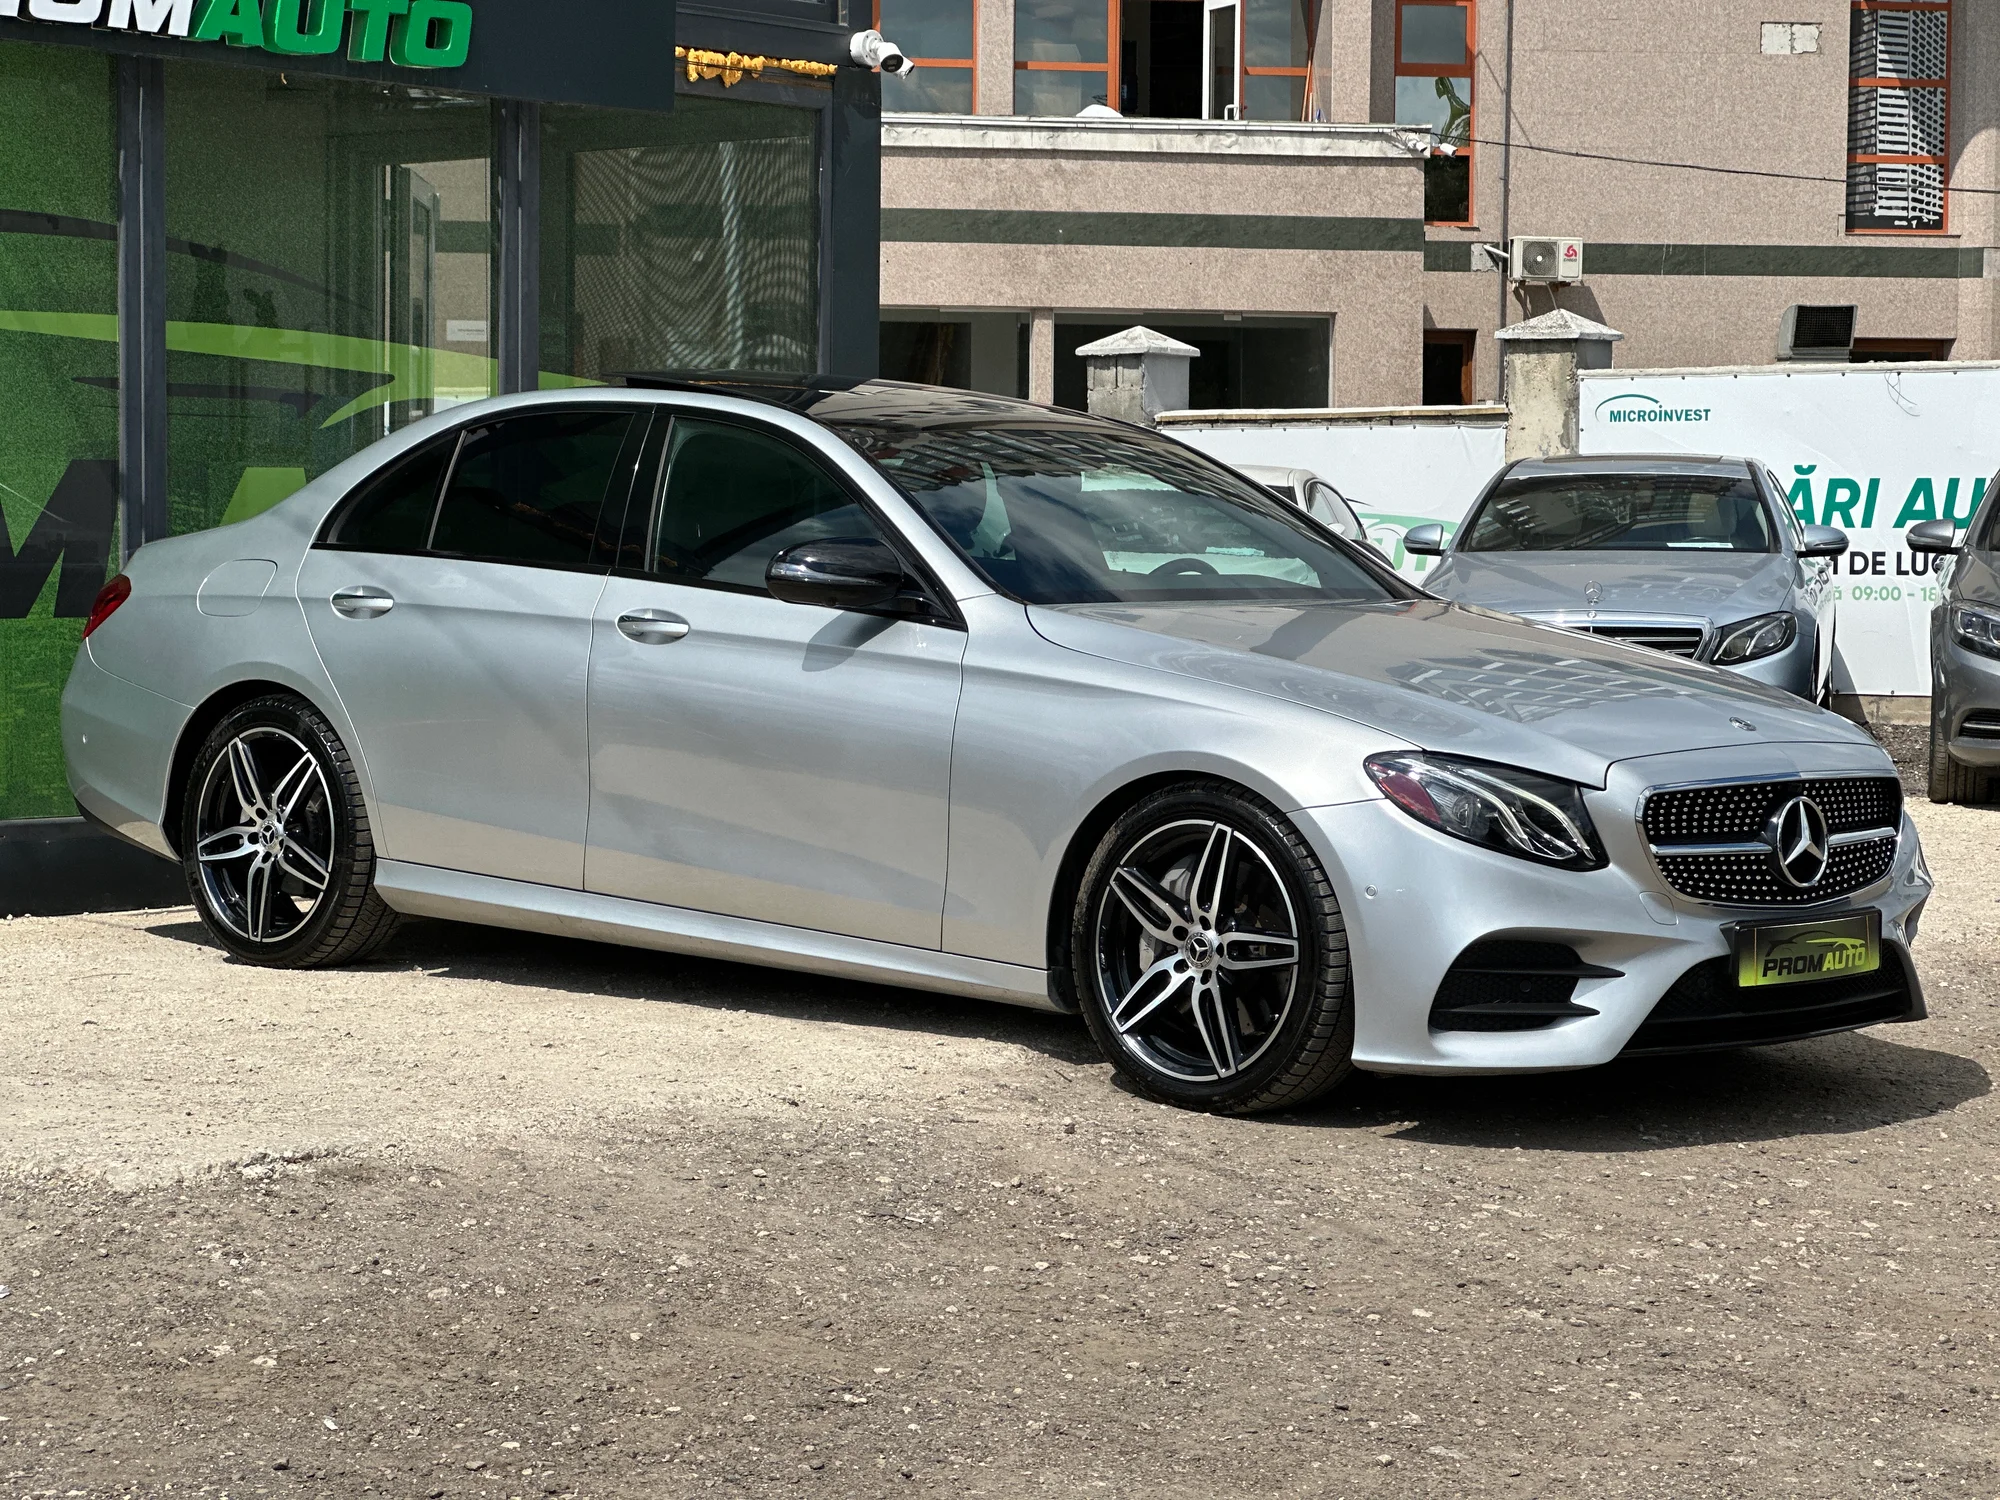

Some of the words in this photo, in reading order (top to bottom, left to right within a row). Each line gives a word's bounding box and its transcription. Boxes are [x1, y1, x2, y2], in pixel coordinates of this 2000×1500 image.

[0, 0, 473, 68] MAUTO
[1892, 477, 1994, 529] AU
[1849, 551, 1886, 575] DE
[1852, 586, 1902, 601] 09:00
[1762, 947, 1866, 978] PROMAUTO
